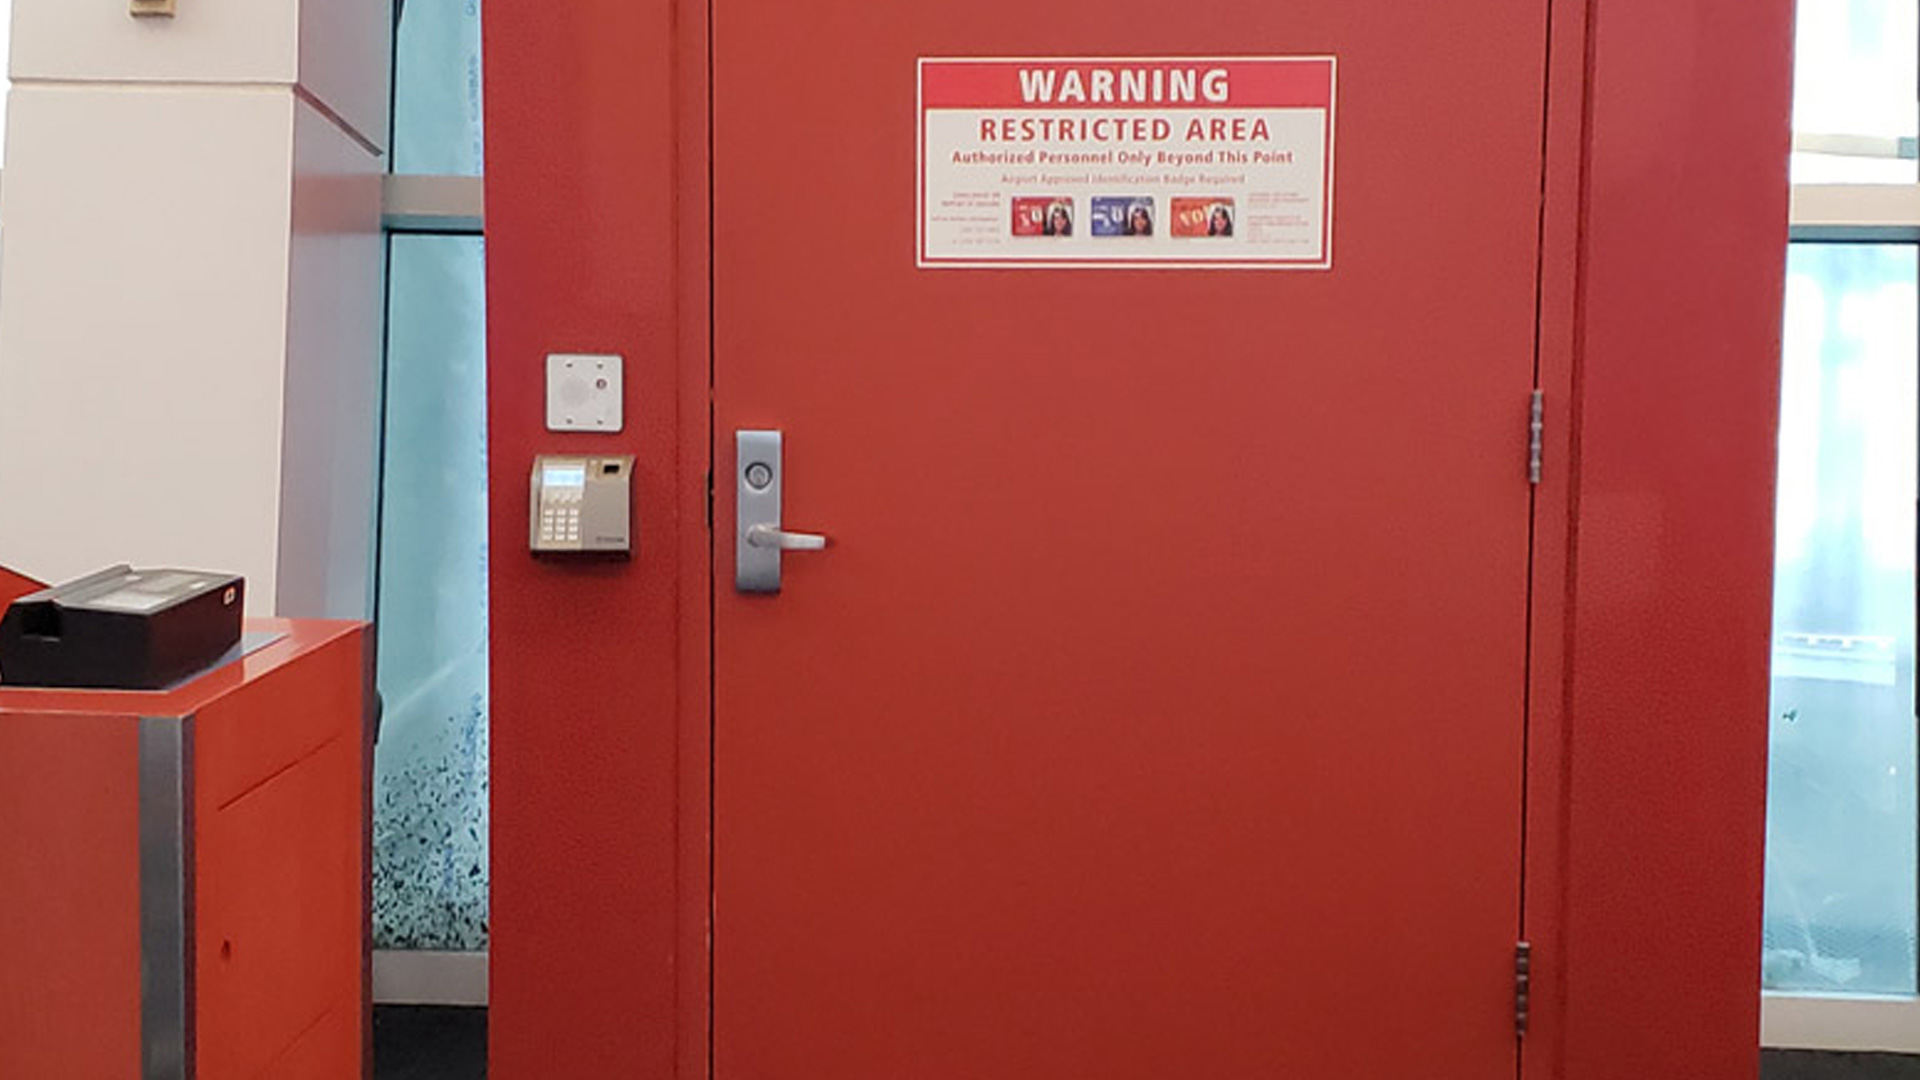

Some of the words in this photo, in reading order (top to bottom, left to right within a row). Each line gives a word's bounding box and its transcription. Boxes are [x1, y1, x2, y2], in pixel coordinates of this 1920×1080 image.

[1019, 69, 1230, 103] WARNING
[980, 118, 1171, 142] RESTRICTED
[1186, 118, 1271, 141] AREA
[952, 150, 1034, 164] Authorized
[1039, 150, 1113, 164] Personnel
[1118, 150, 1152, 167] Only
[1157, 150, 1214, 167] Beyond
[1219, 150, 1248, 164] This
[1253, 150, 1294, 164] Point
[1001, 173, 1037, 187] Airport
[1040, 173, 1089, 187] Approved
[1091, 173, 1161, 185] Identification
[1163, 173, 1195, 187] Badge
[1199, 173, 1245, 187] Required
